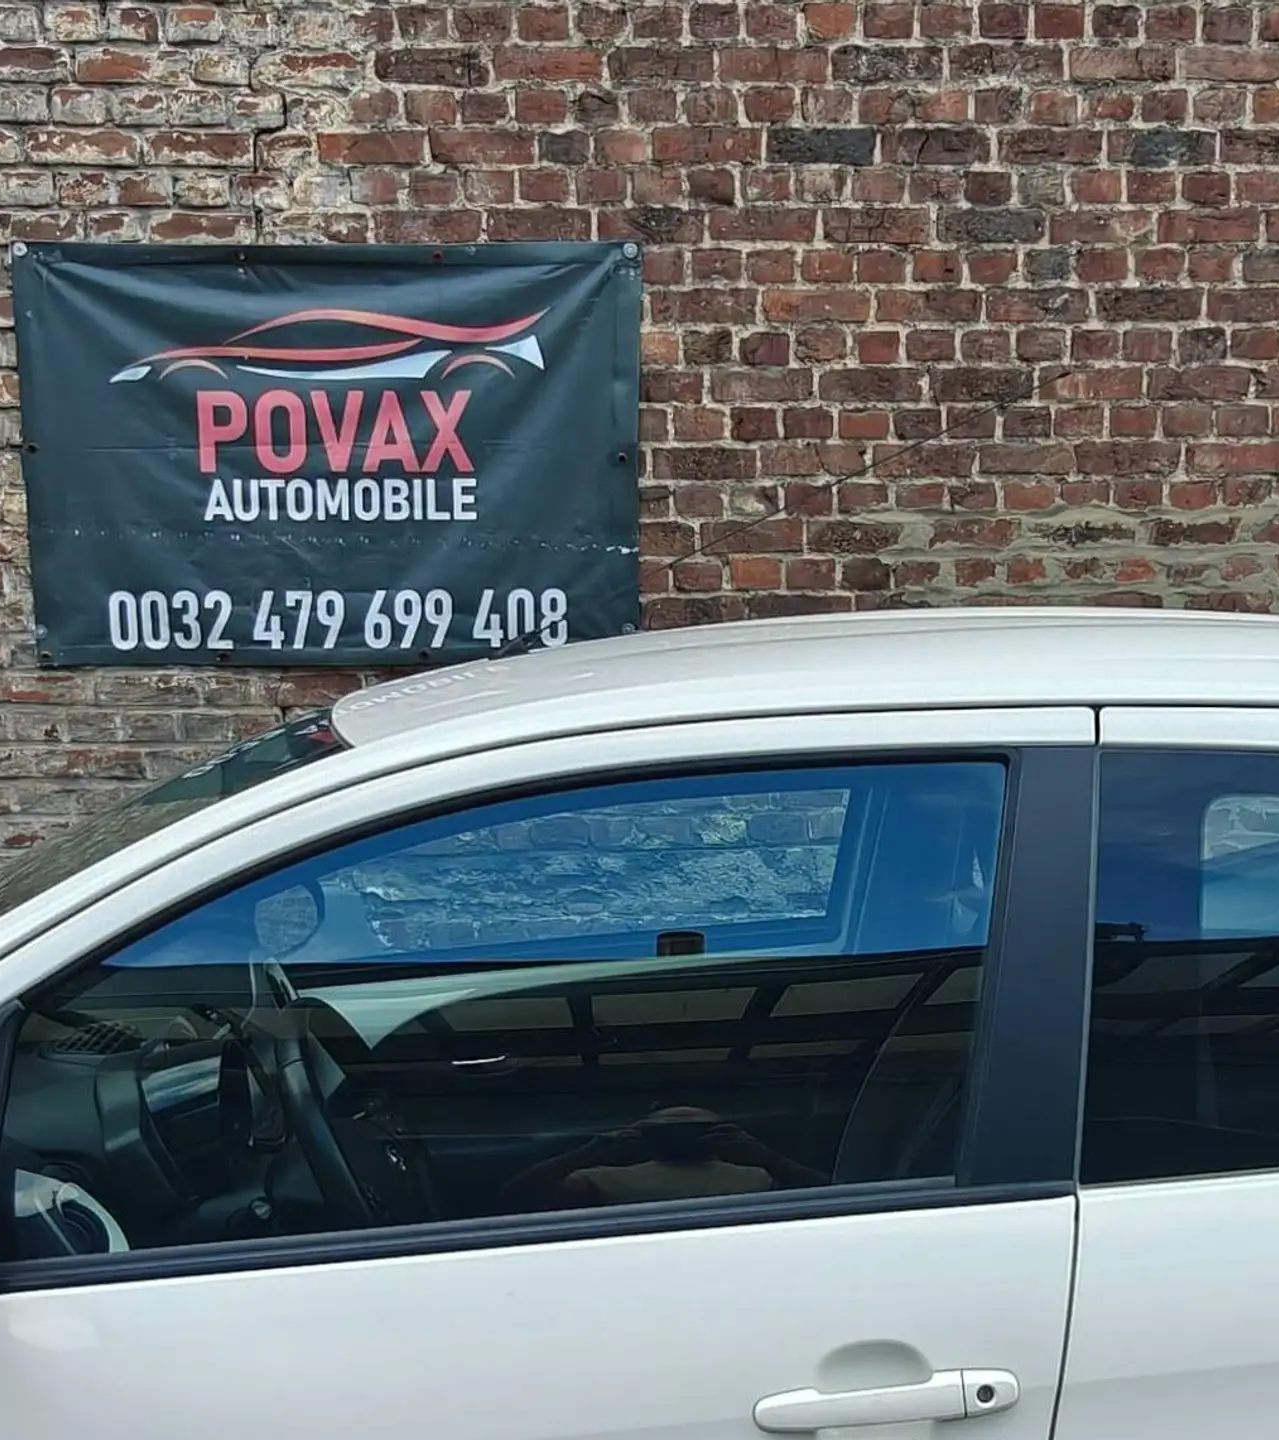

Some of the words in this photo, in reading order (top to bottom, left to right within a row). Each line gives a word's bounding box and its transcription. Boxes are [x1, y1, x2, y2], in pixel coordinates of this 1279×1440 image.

[196, 389, 475, 473] POVAX
[204, 478, 477, 521] AUTOMOBILE
[108, 590, 234, 650] 0032
[252, 590, 345, 649] 479
[364, 588, 453, 649] 699
[472, 588, 568, 648] 408
